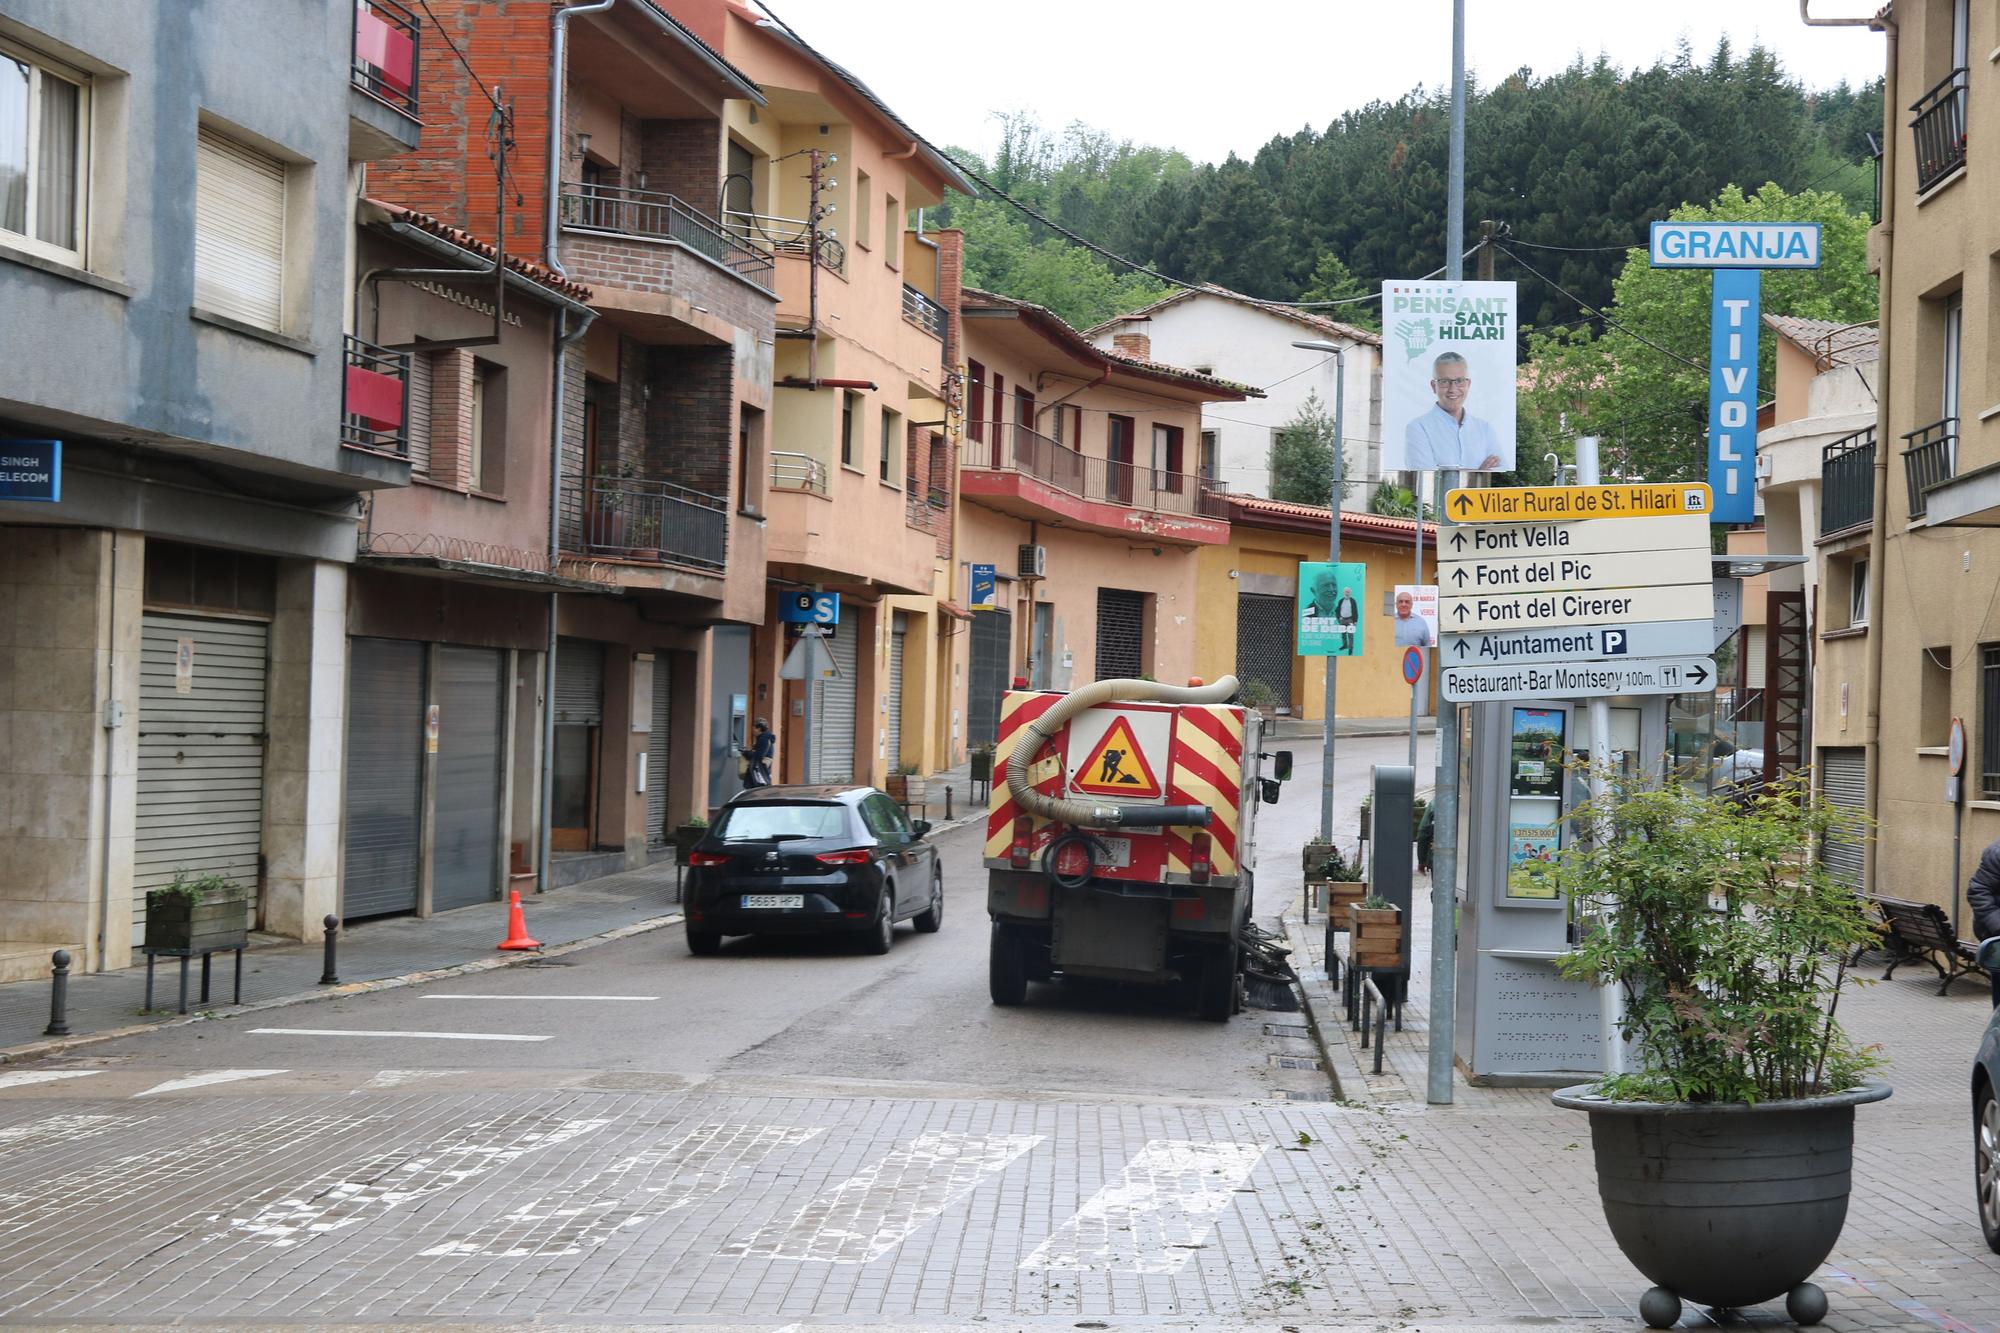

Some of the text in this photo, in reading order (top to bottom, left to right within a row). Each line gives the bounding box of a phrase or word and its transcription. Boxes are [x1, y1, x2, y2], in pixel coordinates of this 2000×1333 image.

[1660, 230, 1809, 260] GRANJA
[1393, 296, 1508, 314] PENSANT
[1455, 311, 1508, 326] SANT
[1440, 326, 1505, 340] HILARI
[1719, 299, 1750, 495] TIVOLI
[1, 456, 40, 467] SINGH
[1479, 489, 1677, 513] Vilar Rural de St. Hilari
[1475, 526, 1570, 550] Font Vella
[1477, 560, 1592, 585] Font del Pic
[800, 597, 834, 623] B S
[1477, 595, 1632, 621] Font del Cirerer
[1479, 631, 1594, 660] Ajuntament
[1449, 669, 1552, 695] Restaurant-Bar
[1626, 671, 1656, 687] 100m.
